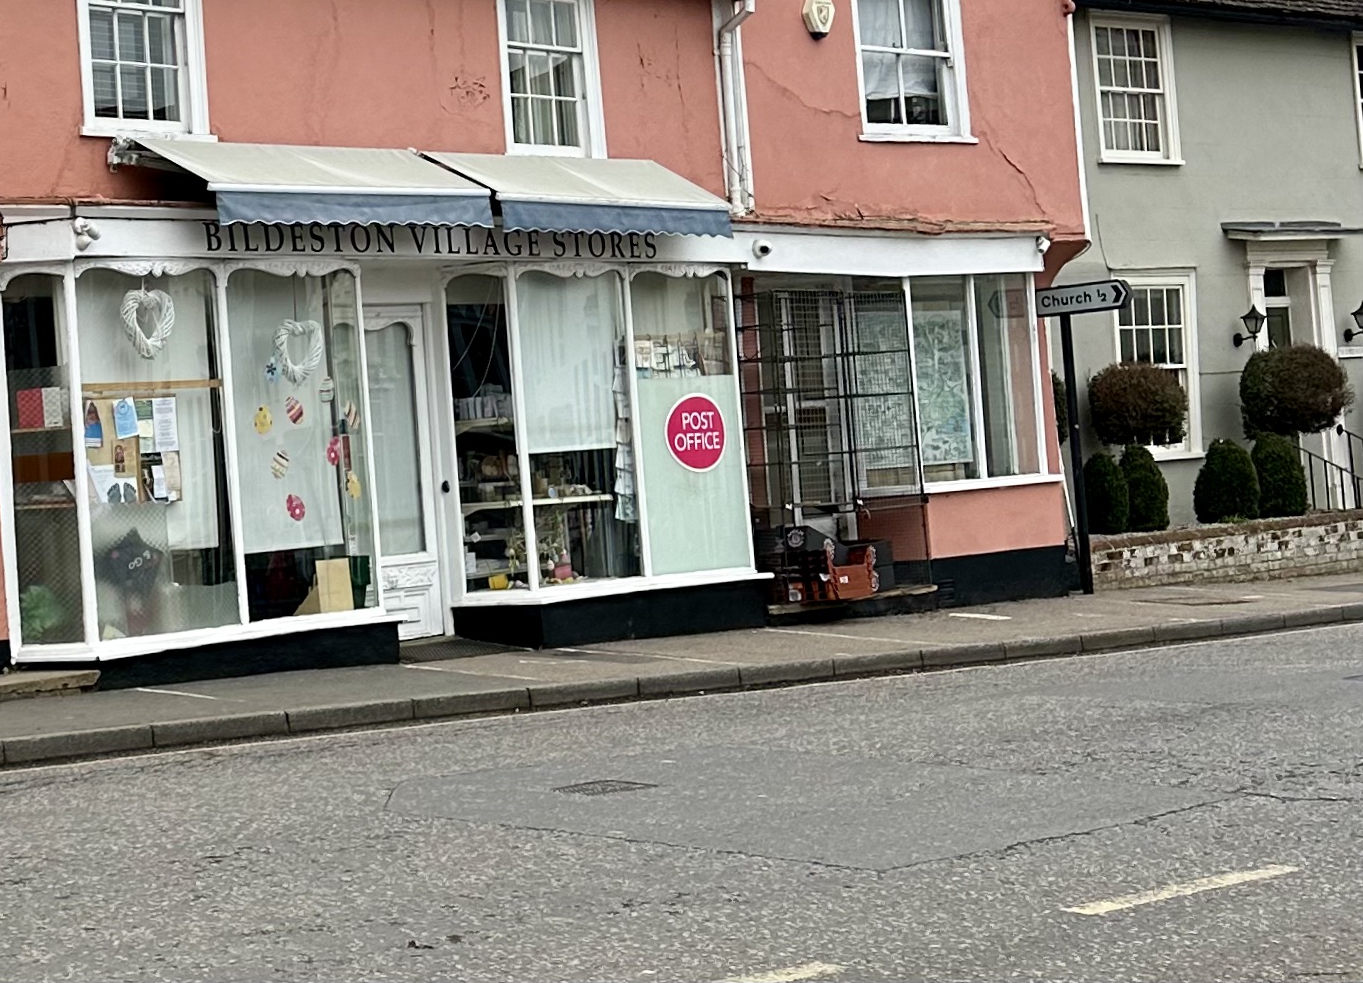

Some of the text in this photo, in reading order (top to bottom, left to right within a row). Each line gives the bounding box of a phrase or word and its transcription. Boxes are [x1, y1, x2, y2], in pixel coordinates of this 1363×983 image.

[203, 221, 657, 259] BILDESTON VILLAGE STORES
[1041, 290, 1092, 308] Church
[681, 411, 714, 430] POST
[674, 432, 721, 452] OFFICE
